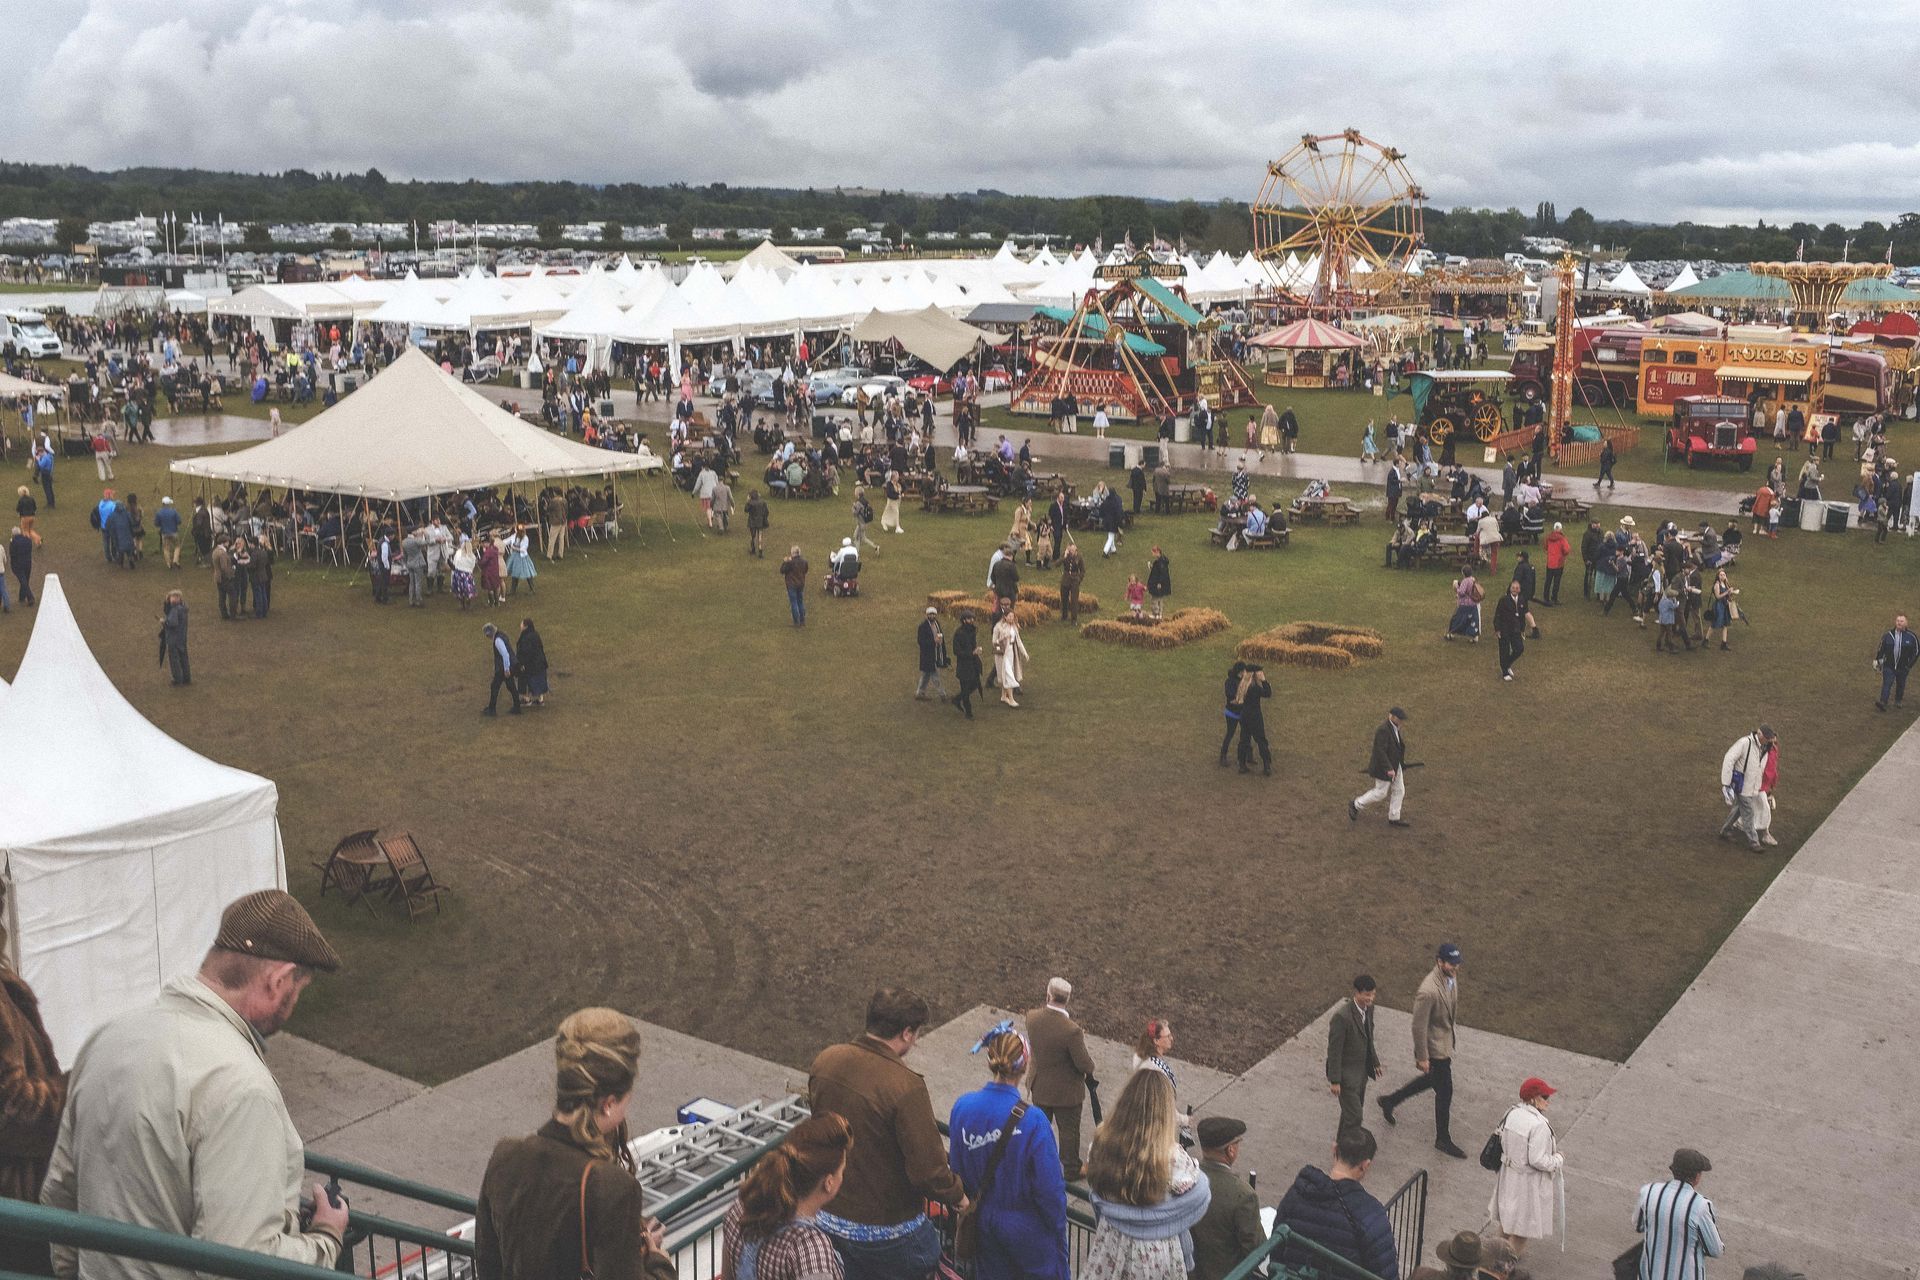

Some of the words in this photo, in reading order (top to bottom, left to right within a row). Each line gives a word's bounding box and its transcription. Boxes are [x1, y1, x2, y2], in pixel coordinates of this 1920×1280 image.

[1728, 348, 1808, 366] TOKENS
[1649, 369, 1658, 384] 1
[1666, 370, 1697, 386] TOKEN
[1647, 386, 1663, 397] £3
[961, 1126, 1022, 1151] Vesp
